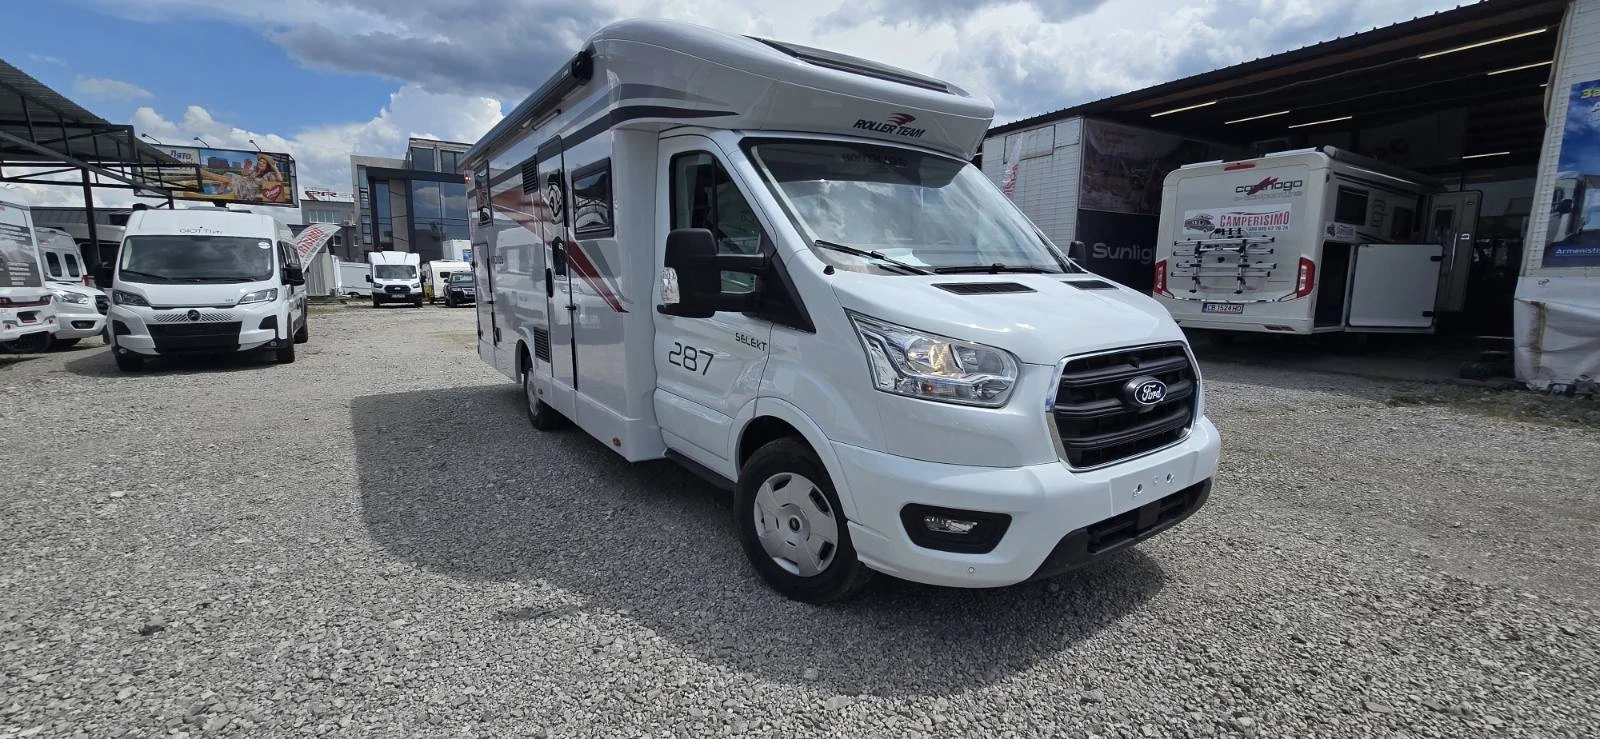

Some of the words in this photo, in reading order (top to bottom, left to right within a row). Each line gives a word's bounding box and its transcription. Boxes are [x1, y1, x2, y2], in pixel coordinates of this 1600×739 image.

[853, 119, 897, 134] ROLLER
[896, 126, 926, 138] TEAM
[1220, 211, 1290, 228] CAMPERISIMO
[735, 332, 768, 351] SELEKT
[668, 341, 714, 376] 287
[1141, 384, 1162, 401] Ford
